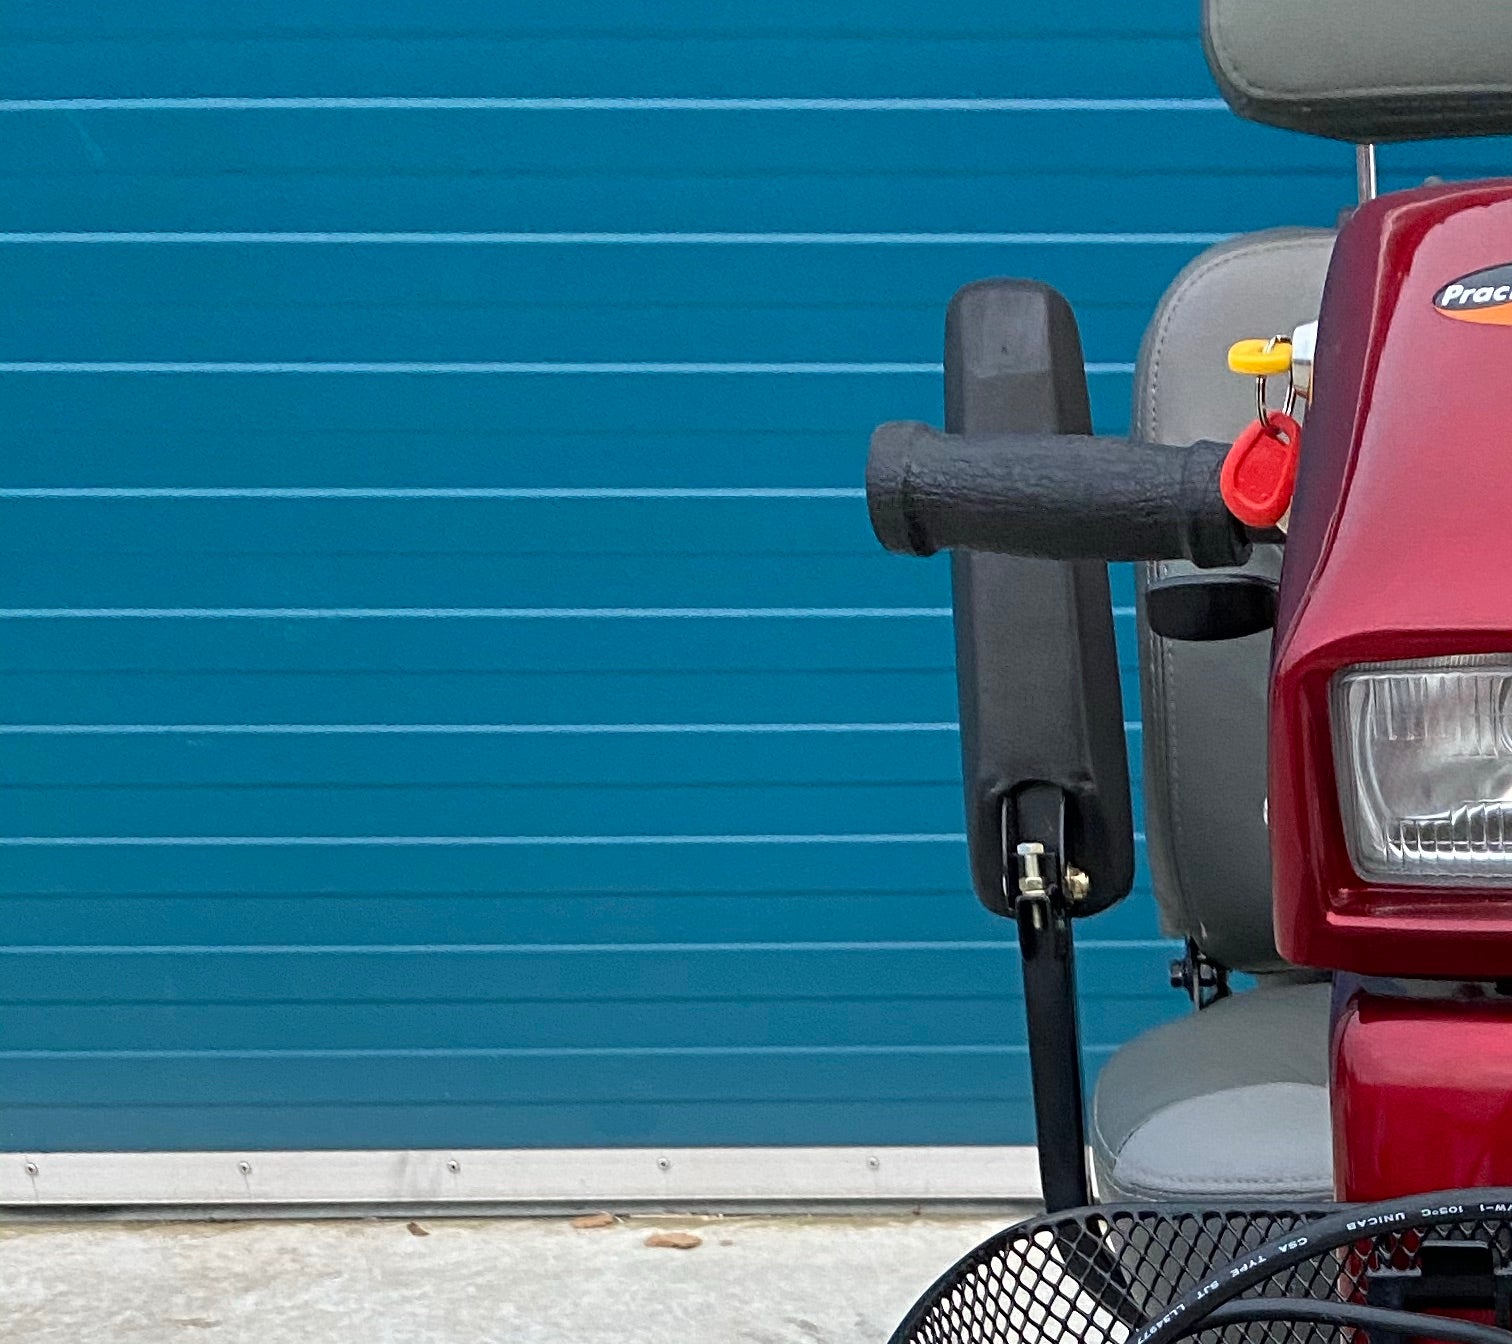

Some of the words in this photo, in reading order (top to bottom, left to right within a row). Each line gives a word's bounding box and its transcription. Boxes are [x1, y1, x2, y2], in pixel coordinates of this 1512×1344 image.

[1345, 1211, 1406, 1232] UNICAB
[1277, 1236, 1309, 1253] CSA
[1229, 1255, 1267, 1278] TYPE
[1195, 1279, 1220, 1300] SJT
